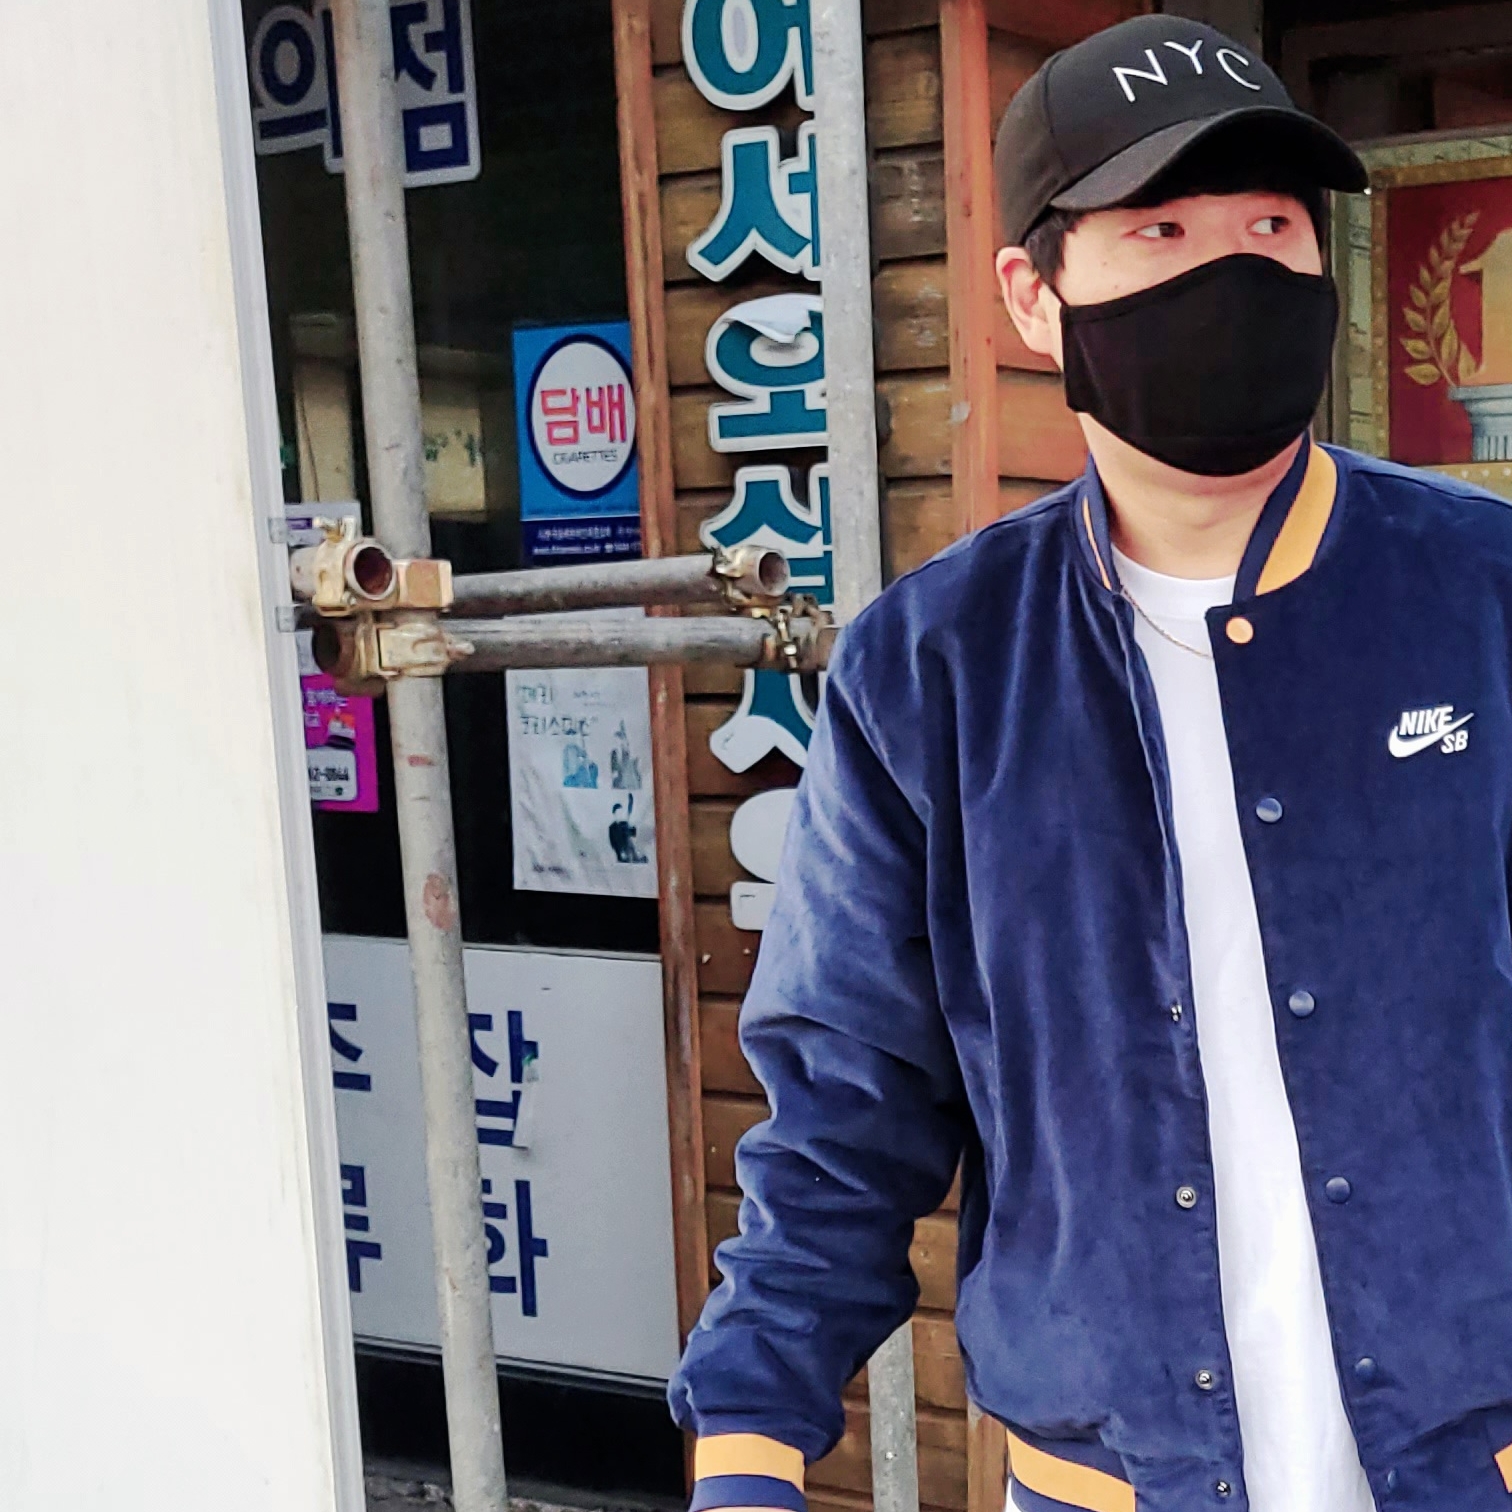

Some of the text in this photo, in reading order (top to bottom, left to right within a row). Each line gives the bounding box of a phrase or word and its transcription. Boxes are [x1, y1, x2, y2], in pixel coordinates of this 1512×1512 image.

[1112, 40, 1261, 102] NYC
[540, 384, 627, 446] 담배
[1399, 706, 1453, 735] NIKE
[1441, 730, 1468, 753] SB
